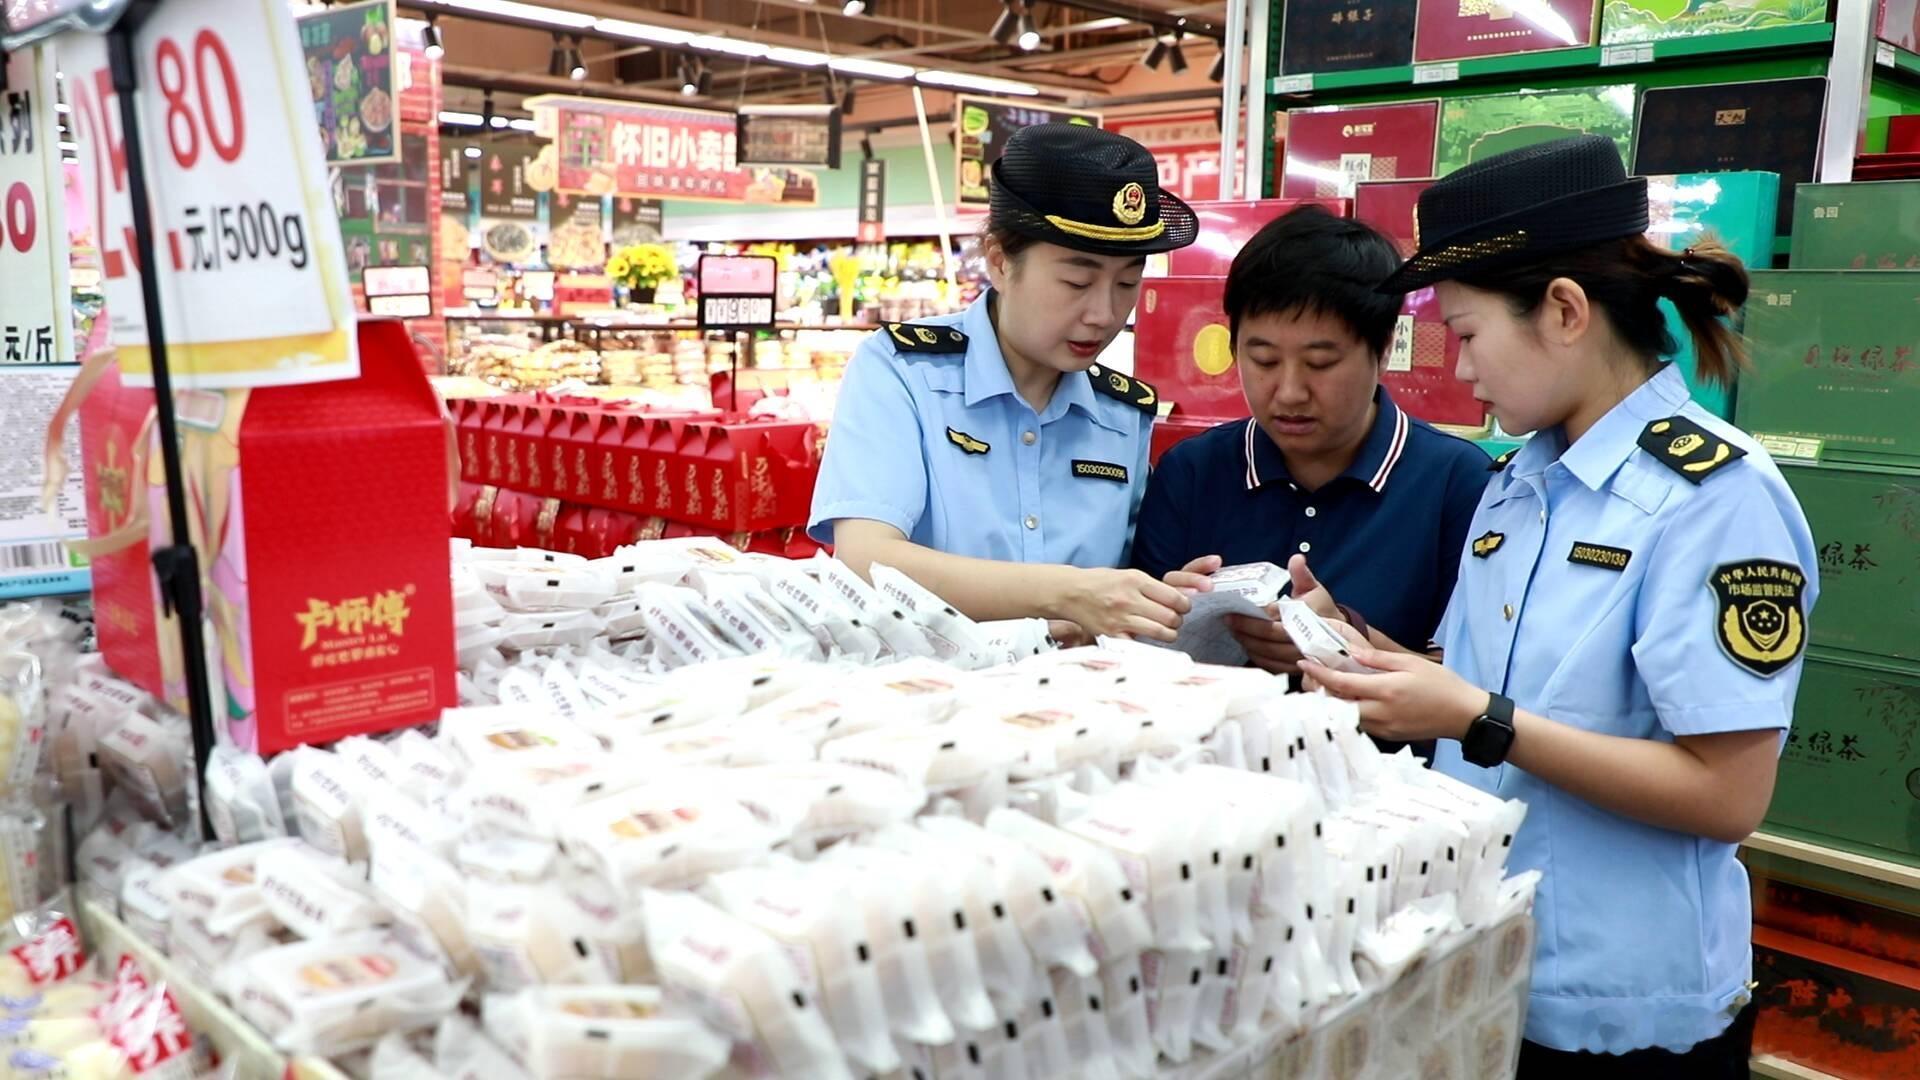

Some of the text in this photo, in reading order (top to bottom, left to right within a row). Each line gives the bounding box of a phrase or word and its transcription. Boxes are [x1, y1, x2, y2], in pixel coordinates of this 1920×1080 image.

[156, 28, 244, 169] 80
[0, 182, 36, 253] 0
[185, 201, 308, 269] 元/500g
[5, 325, 53, 362] 元/斤
[1819, 541, 1878, 571] 绿茶
[1719, 565, 1802, 587] 中华人民共和国
[1728, 582, 1796, 598] 市场监管执法
